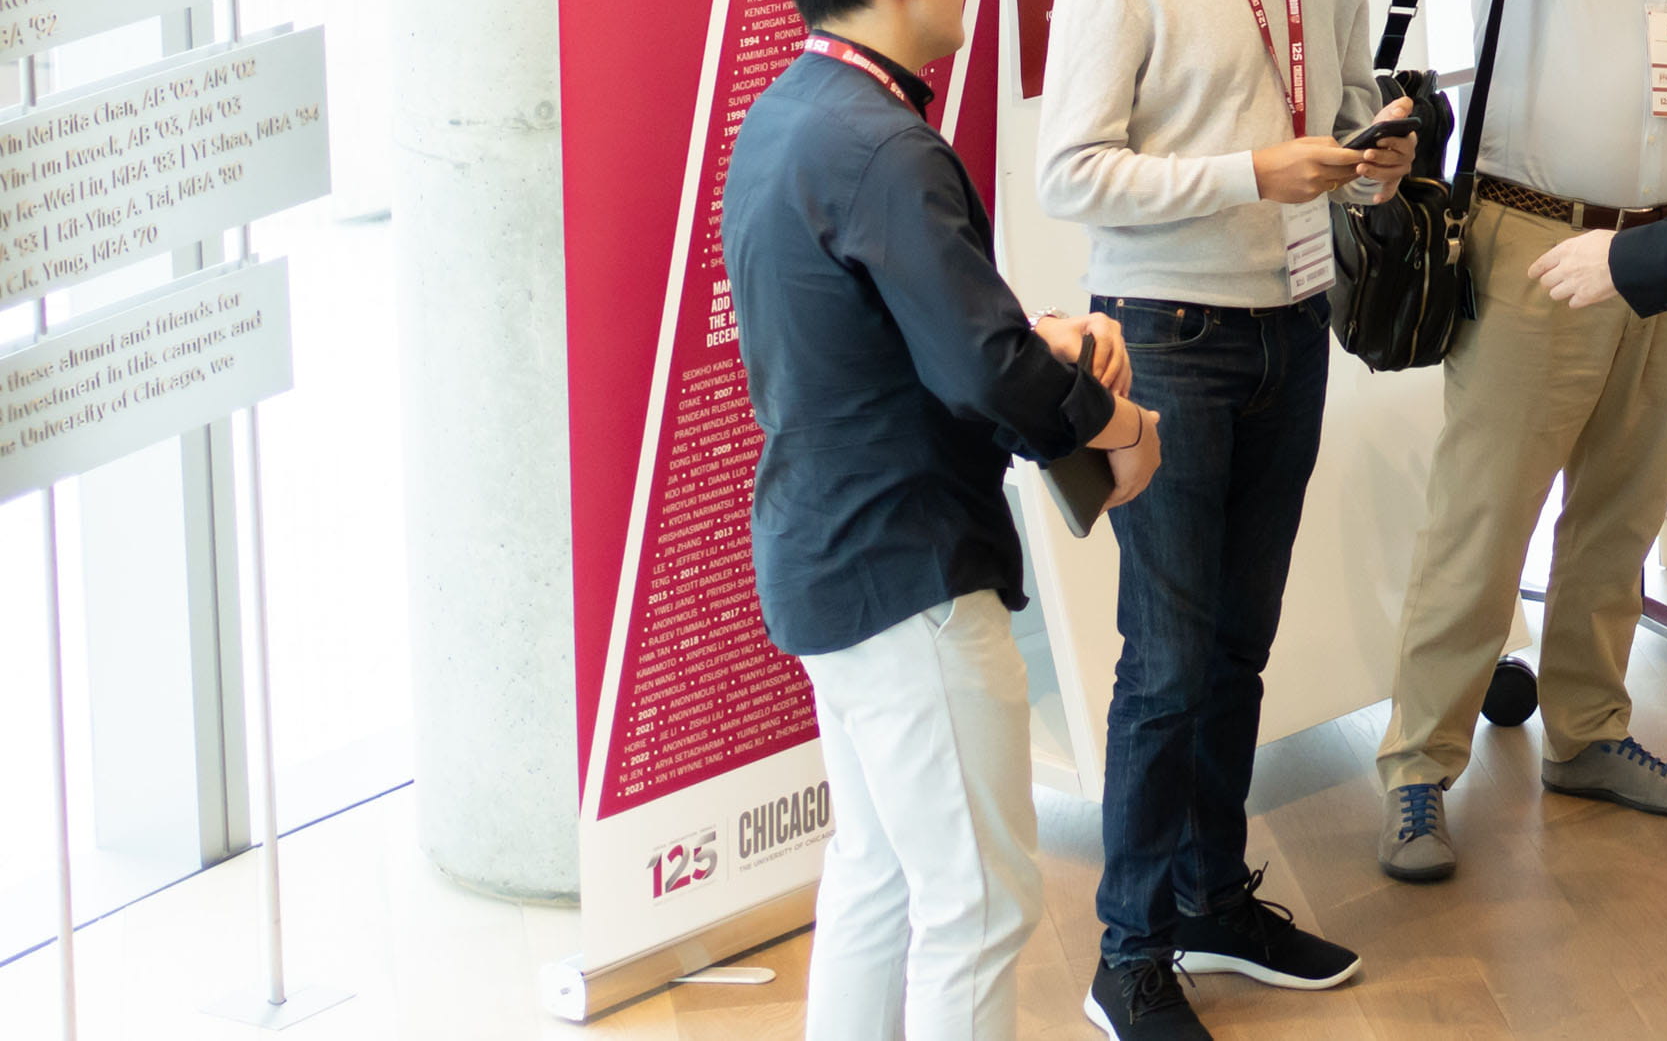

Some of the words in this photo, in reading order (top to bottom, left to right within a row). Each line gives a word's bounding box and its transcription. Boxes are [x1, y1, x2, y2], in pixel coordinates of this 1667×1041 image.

[752, 16, 786, 31] MORGAN
[739, 36, 760, 47] 1994
[775, 26, 803, 41] RONNIE
[1292, 42, 1303, 62] 125
[711, 297, 730, 313] ADD
[120, 320, 152, 348] and
[156, 301, 213, 335] friends
[217, 292, 241, 312] for
[709, 313, 726, 330] THE
[127, 351, 158, 375] this
[162, 328, 227, 362] campus
[231, 309, 263, 337] and
[713, 359, 733, 371] KANG
[133, 366, 206, 403] Chicago,
[209, 354, 236, 374] we
[713, 387, 733, 399] 2007
[714, 526, 733, 539] 2013
[648, 590, 668, 604] 2015
[646, 830, 718, 899] 125
[739, 780, 830, 859] CHICAGO
